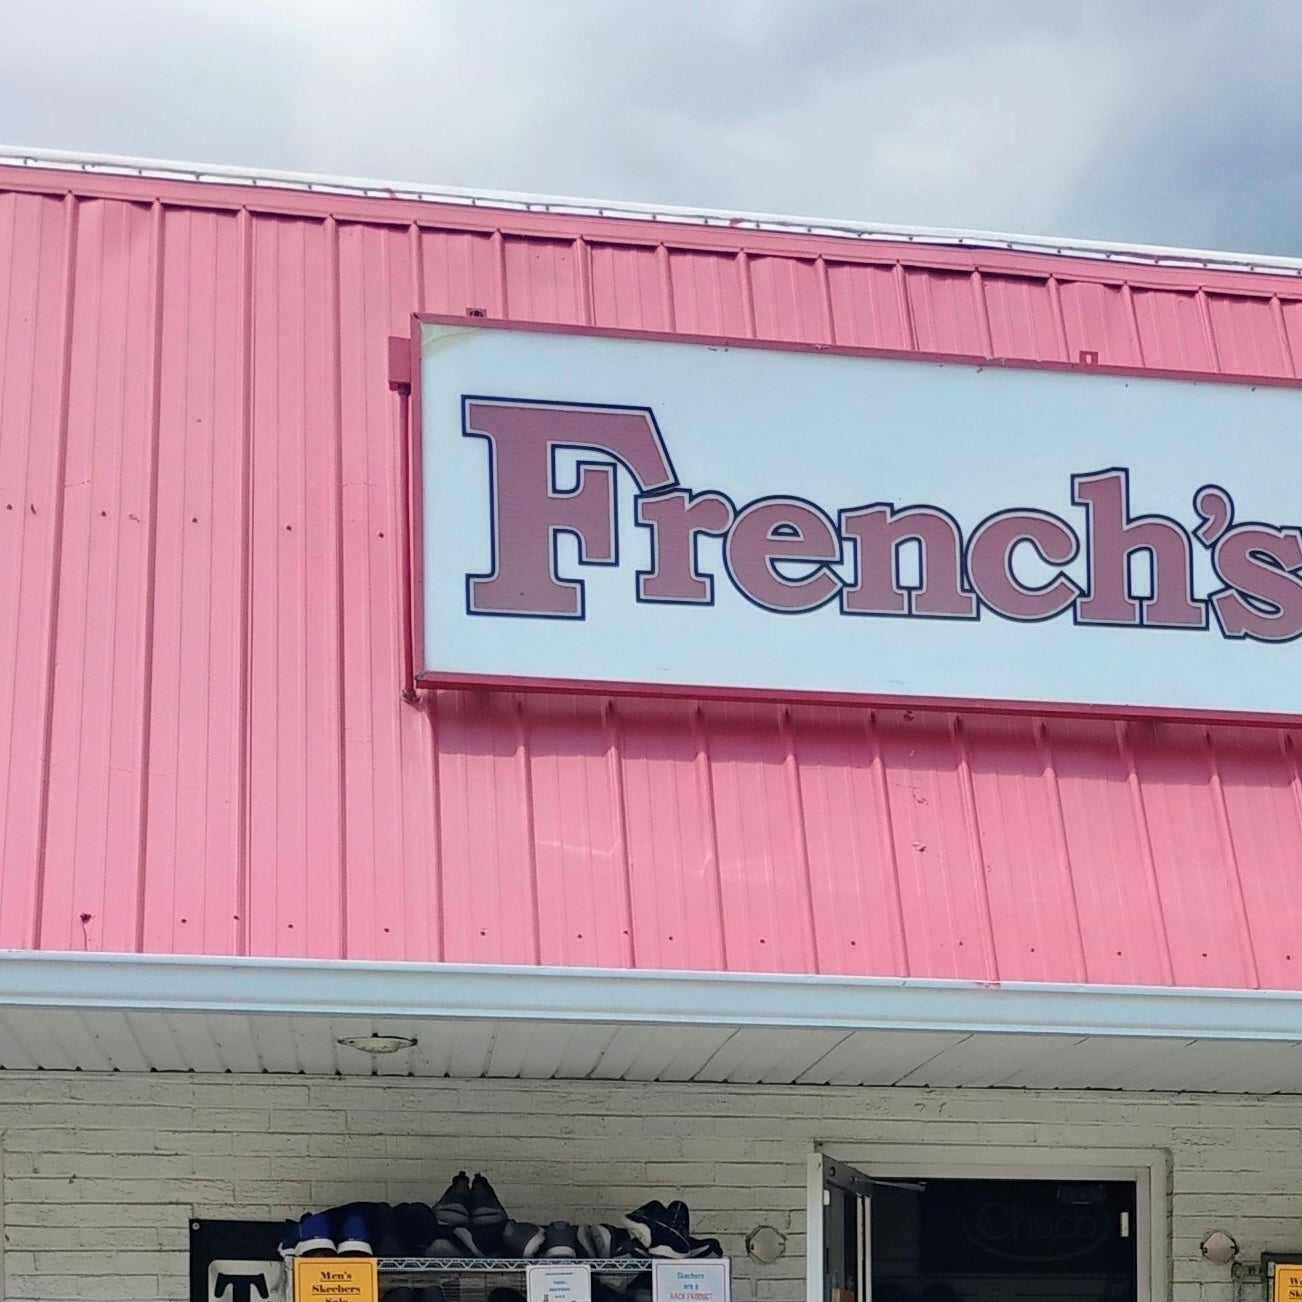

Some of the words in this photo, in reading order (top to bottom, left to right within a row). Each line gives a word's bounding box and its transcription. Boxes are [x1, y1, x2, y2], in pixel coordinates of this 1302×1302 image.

[977, 1198, 1097, 1241] Chaco
[321, 1272, 352, 1280] Men's
[676, 1272, 705, 1280] Skechers
[312, 1284, 361, 1293] Skechers
